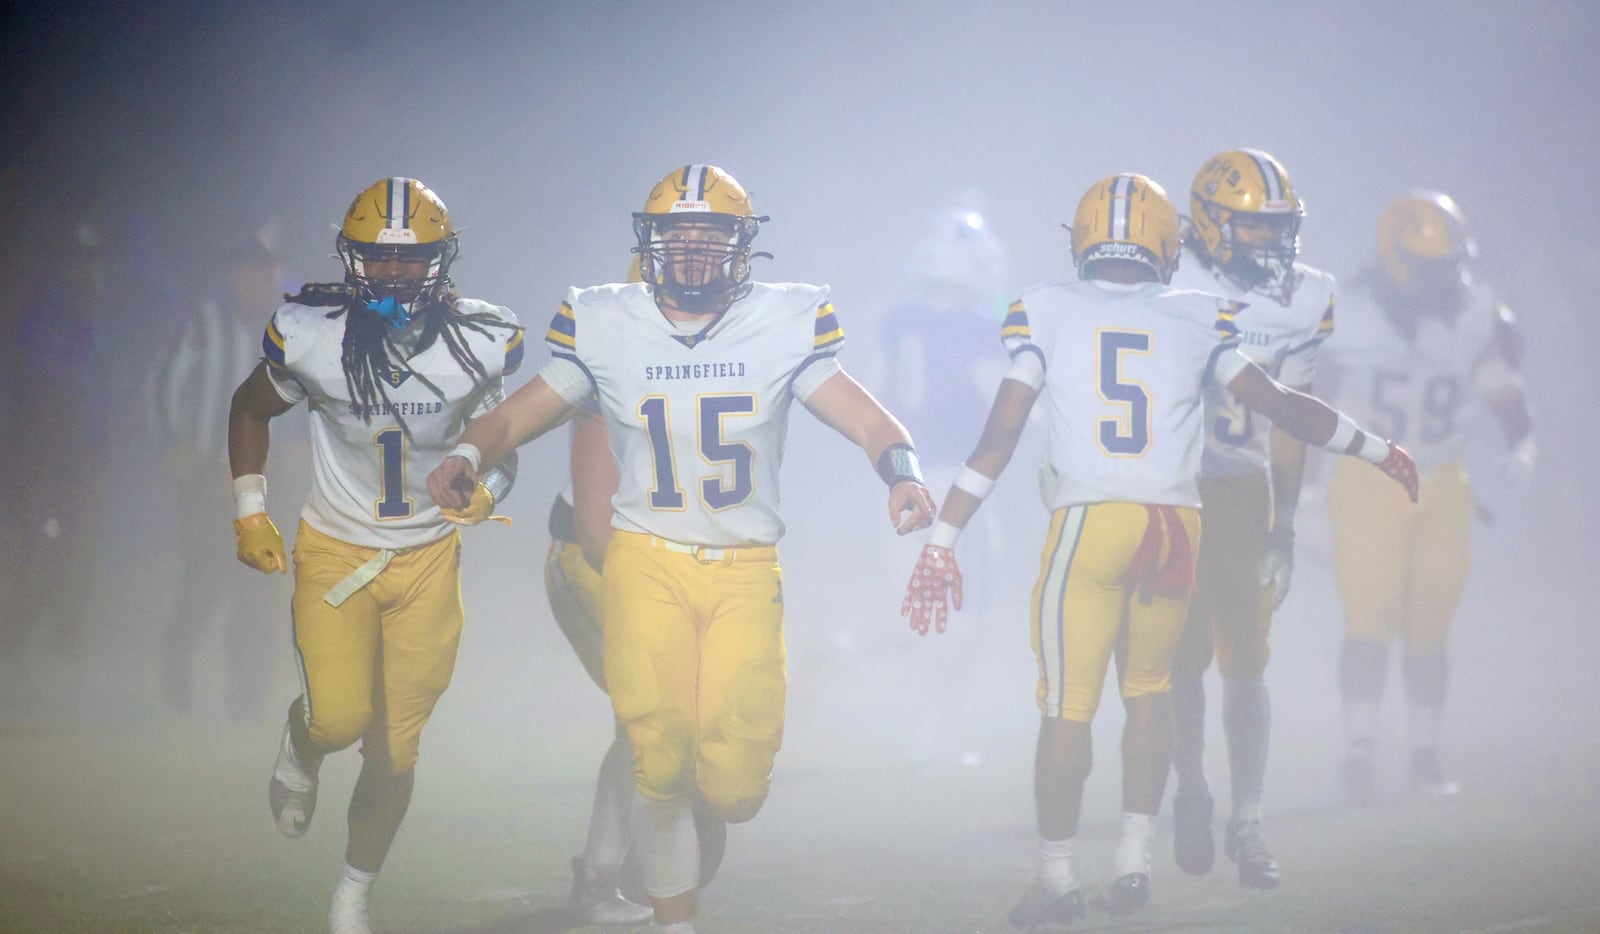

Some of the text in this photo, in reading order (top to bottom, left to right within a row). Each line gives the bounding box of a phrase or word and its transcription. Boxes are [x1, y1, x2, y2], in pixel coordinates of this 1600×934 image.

[391, 372, 400, 384] S
[646, 362, 745, 381] SPRINGFIELD
[1096, 327, 1155, 457] 5
[348, 403, 442, 415] SRINGFIELD
[373, 426, 414, 522] 1
[635, 391, 758, 513] 15
